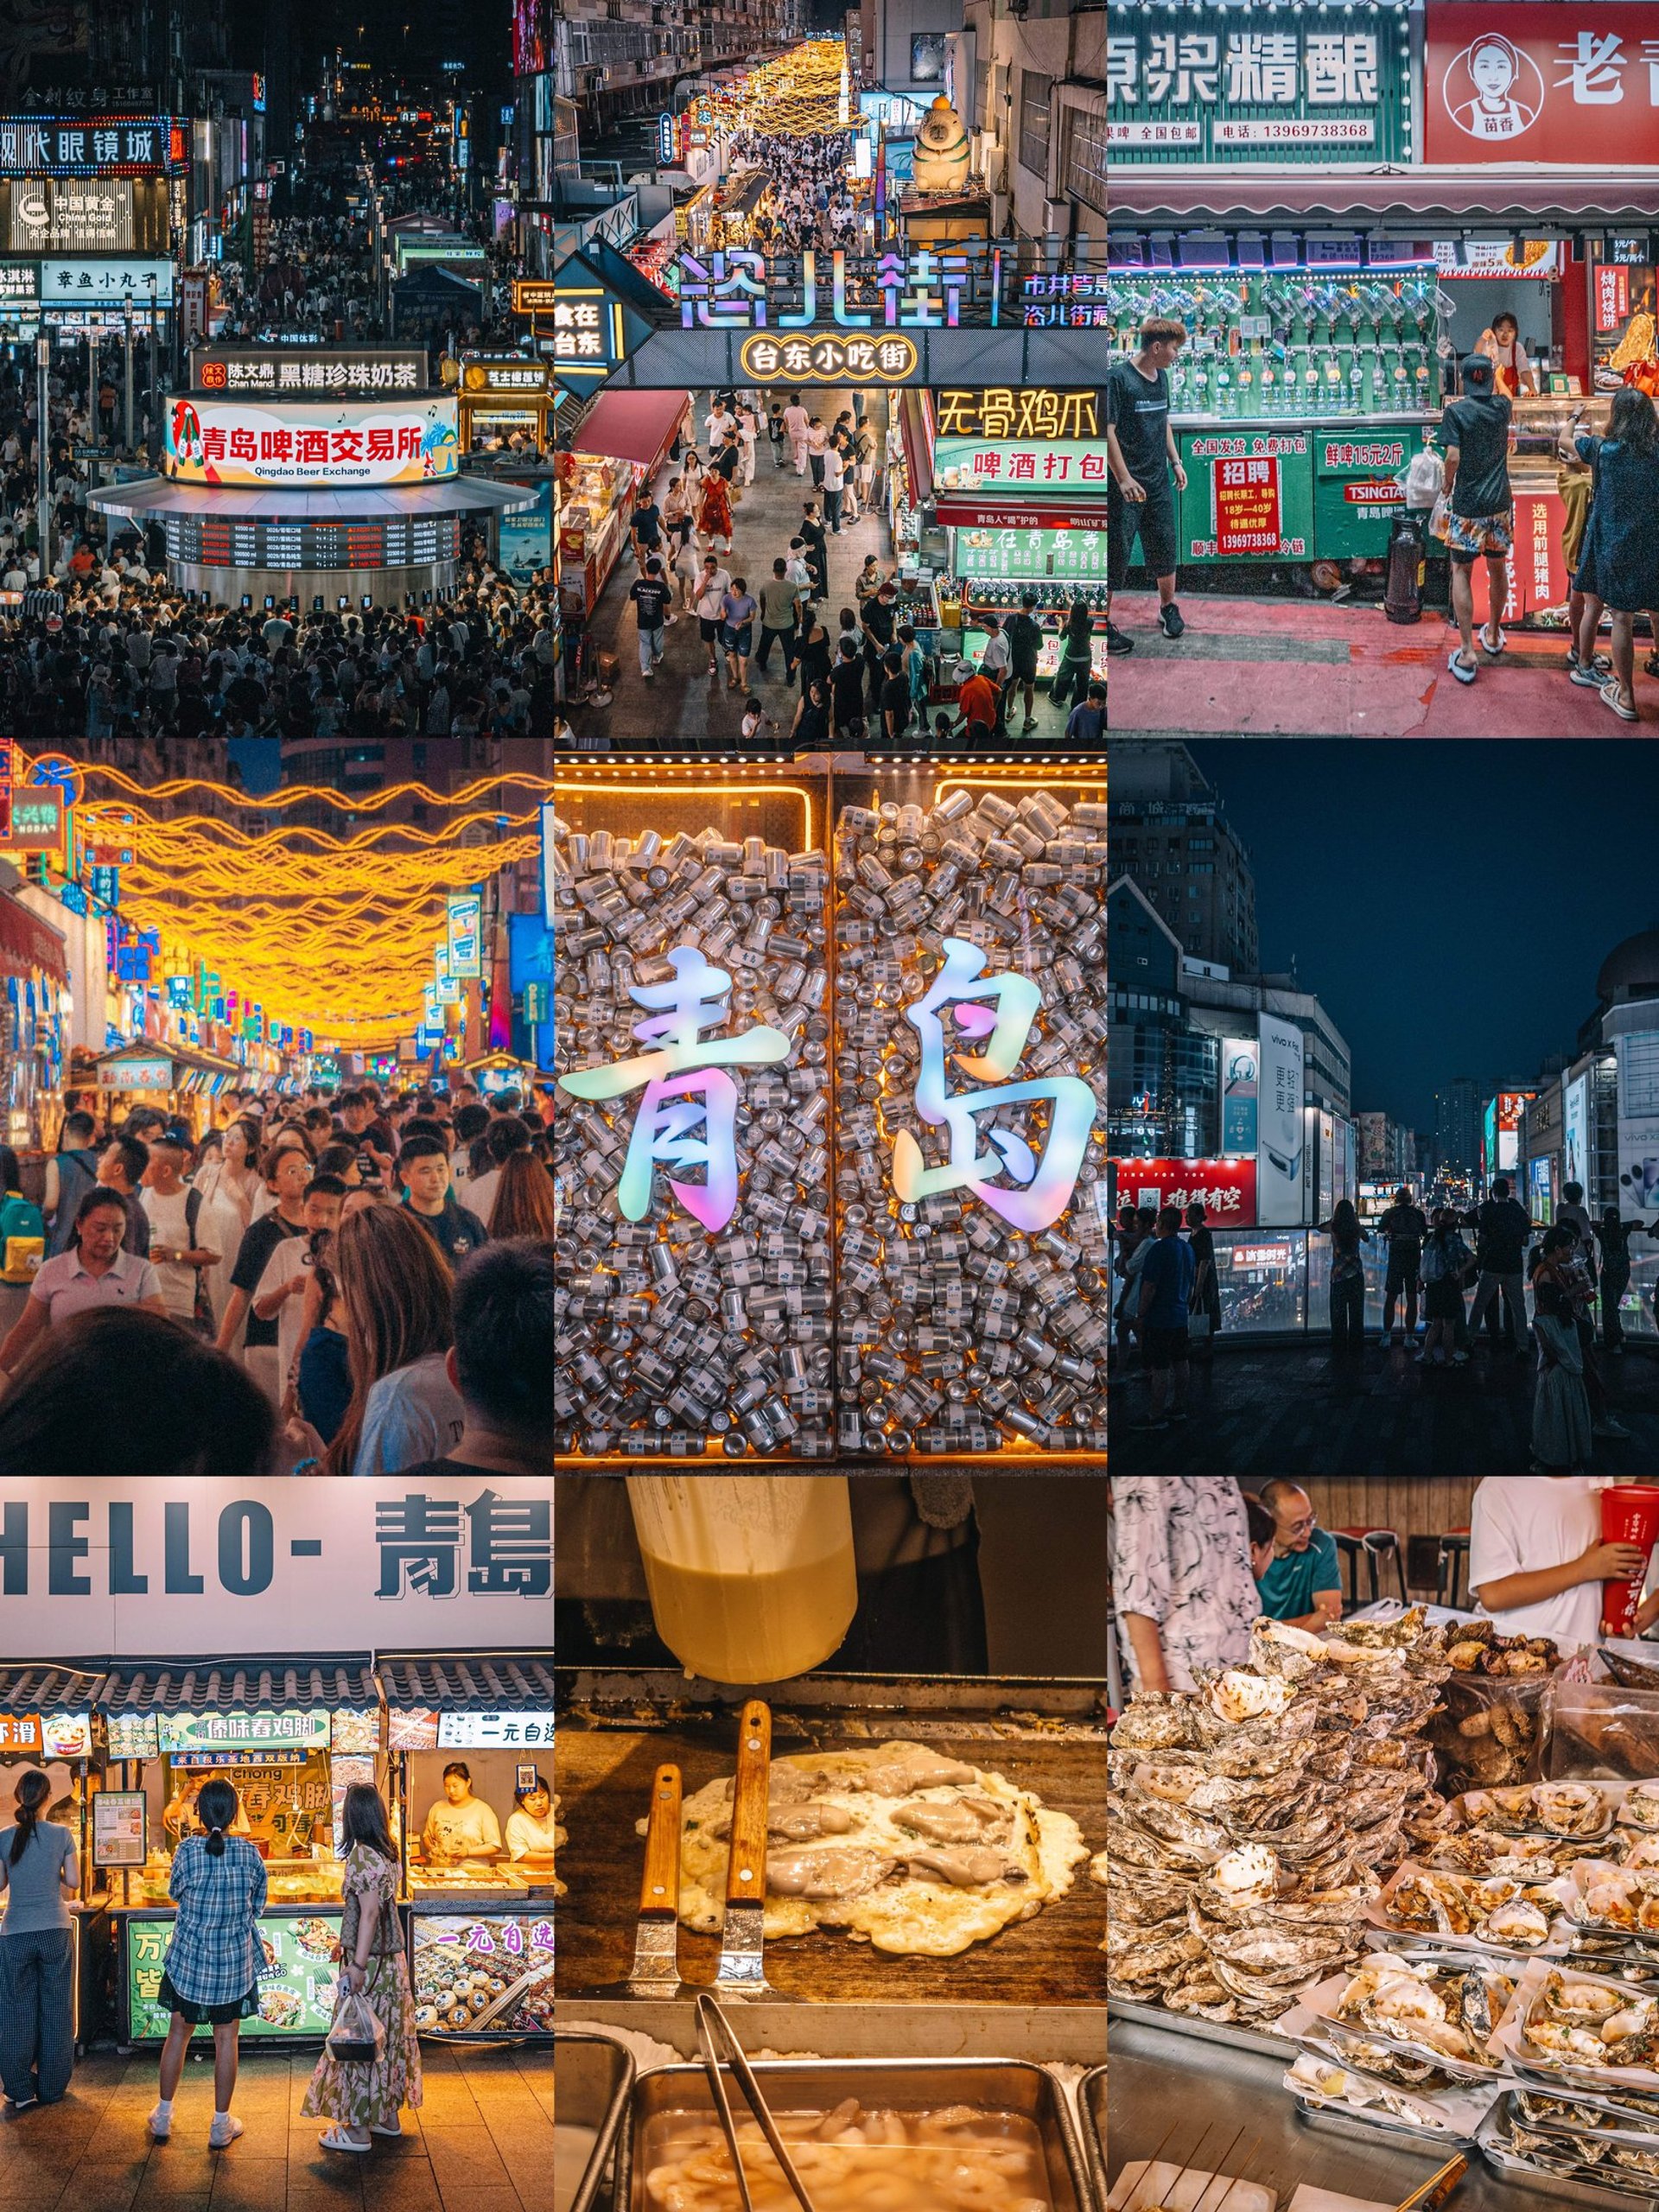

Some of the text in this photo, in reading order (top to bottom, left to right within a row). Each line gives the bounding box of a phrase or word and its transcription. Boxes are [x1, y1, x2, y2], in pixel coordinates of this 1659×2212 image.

[1553, 31, 1659, 107] 老
[1141, 126, 1198, 140] 全国包邮
[54, 195, 116, 212] 中国黄金
[59, 213, 112, 222] China Gold
[57, 270, 157, 289] 章鱼小丸子
[679, 250, 968, 327] 恣儿街
[1601, 270, 1616, 327] 烤肉烧饼
[281, 334, 318, 343] 中国体彩
[554, 331, 601, 355] 台东
[752, 343, 907, 371] 台东小吃街
[228, 363, 417, 388] 陈文鼎 黑糖珍珠奶茶
[938, 389, 1098, 439] 无骨鸡爪
[202, 426, 423, 464] 青岛啤酒交易所
[1192, 438, 1306, 454] 全国发货 免费打包
[1325, 442, 1404, 467] 鲜啤15元2斤
[255, 466, 371, 478] Qingdao Beer Exchange
[973, 450, 1107, 481] 啤酒打包
[1223, 461, 1270, 485] 招聘
[1223, 532, 1277, 549] 13969738368
[1532, 502, 1550, 601] 选用前腿猪肉
[557, 938, 1097, 1234] 青岛
[1162, 1185, 1242, 1212] 难得有空
[374, 1488, 553, 1599] 青島
[207, 1717, 315, 1738] 傣味舂鸡脚
[177, 1752, 301, 1764] 来自极乐圣地西双版纳
[436, 1923, 554, 1953] 一元自选
